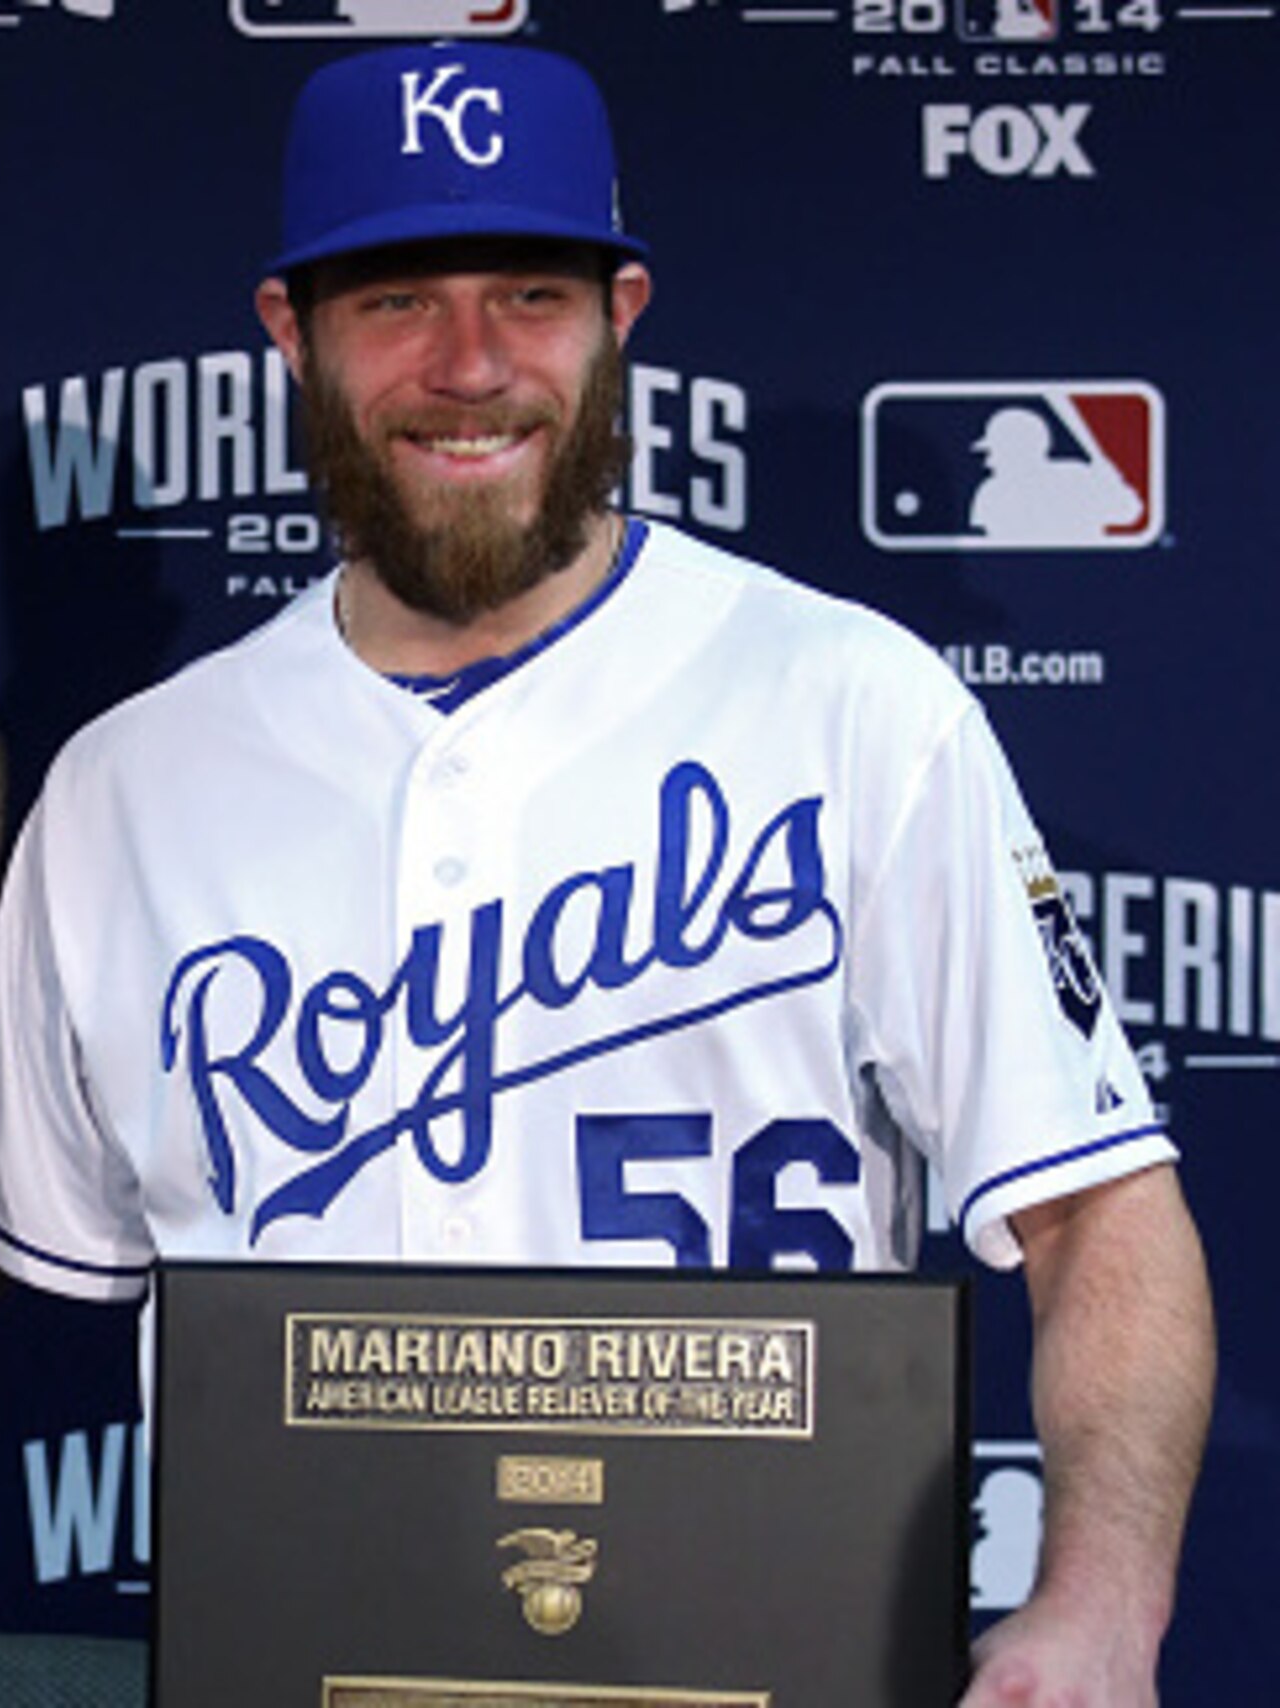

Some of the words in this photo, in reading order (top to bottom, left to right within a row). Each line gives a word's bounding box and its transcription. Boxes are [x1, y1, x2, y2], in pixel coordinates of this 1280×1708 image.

[853, 0, 946, 33] 20
[1074, 0, 1162, 32] 14
[852, 56, 956, 76] FALL
[974, 54, 1167, 76] CLASSIC
[400, 64, 503, 166] KC
[922, 103, 1097, 179] FOX
[23, 346, 308, 532] WORL
[227, 513, 320, 554] 20
[226, 576, 300, 596] FAL
[161, 760, 843, 1248] Royals
[1135, 1042, 1170, 1081] 4
[575, 1112, 862, 1273] 56
[310, 1328, 566, 1379] MARIANO
[587, 1333, 795, 1381] RIVERA
[730, 1389, 794, 1421] YEAR
